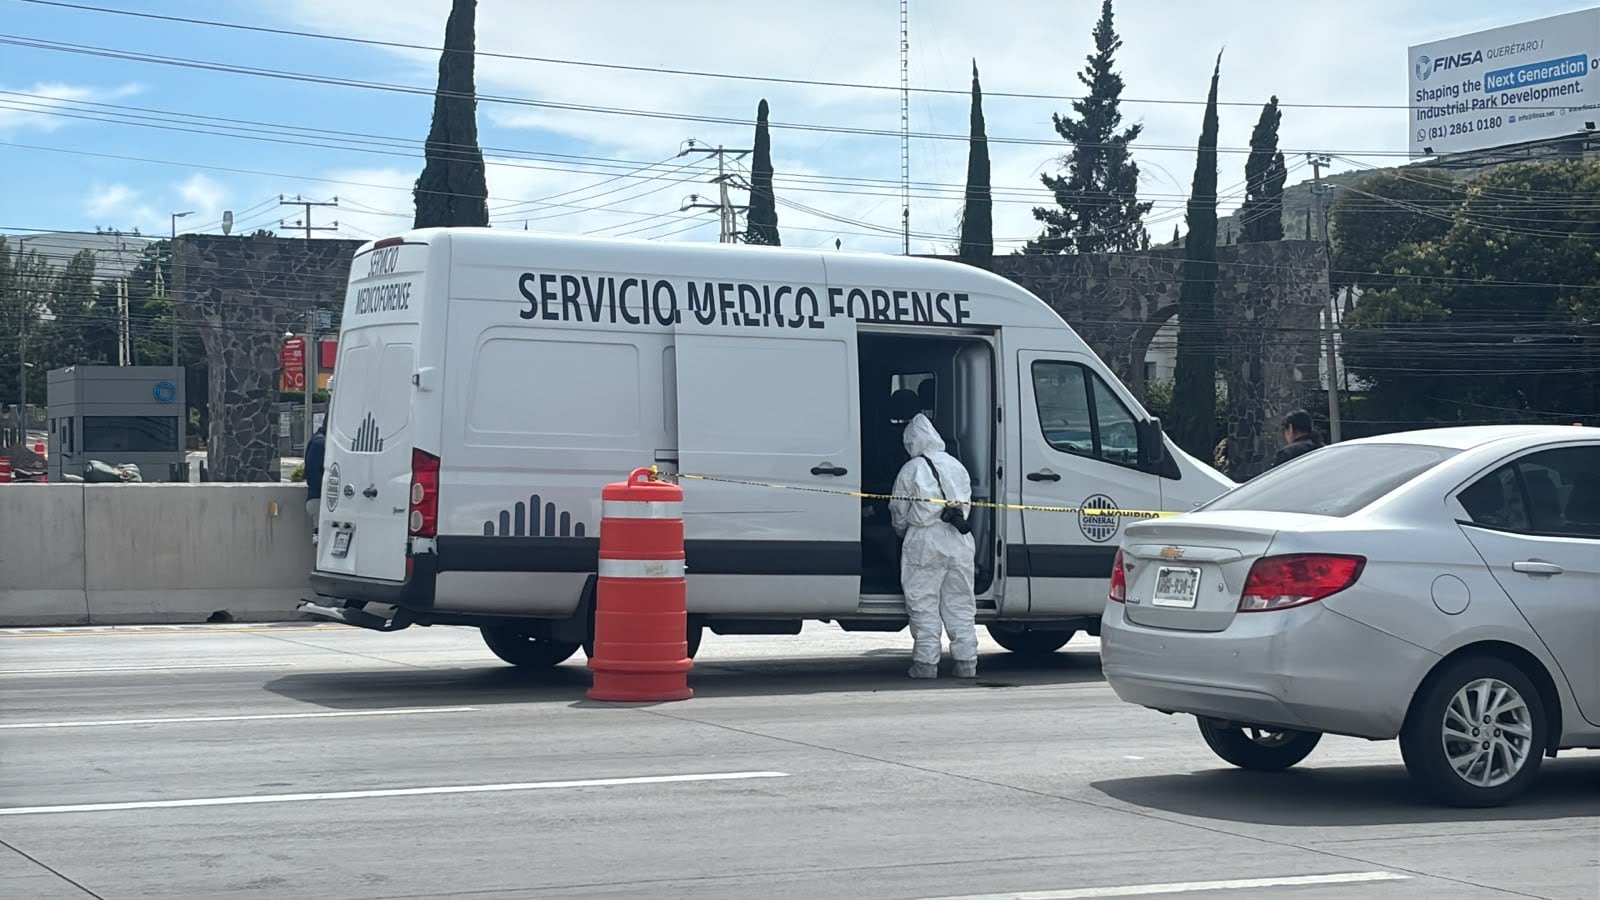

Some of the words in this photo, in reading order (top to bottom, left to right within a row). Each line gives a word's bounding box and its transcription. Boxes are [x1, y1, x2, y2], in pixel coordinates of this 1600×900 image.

[1433, 50, 1483, 72] FINSA
[1487, 40, 1539, 59] QUERÉTARO
[1416, 84, 1460, 102] Shaping
[1462, 80, 1481, 93] the
[1487, 71, 1515, 89] Next
[1517, 60, 1584, 83] Generation
[1591, 58, 1600, 69] o
[1416, 99, 1469, 121] Industrial
[1471, 95, 1498, 111] Park
[1501, 80, 1584, 106] Development.
[1428, 125, 1447, 140] (81)
[1449, 121, 1474, 135] 2861
[1476, 116, 1502, 130] 0180
[368, 246, 399, 278] SERVICIO
[518, 272, 677, 326] SERVICIO
[828, 288, 970, 324] FORENSE
[1082, 516, 1116, 525] GENERAL
